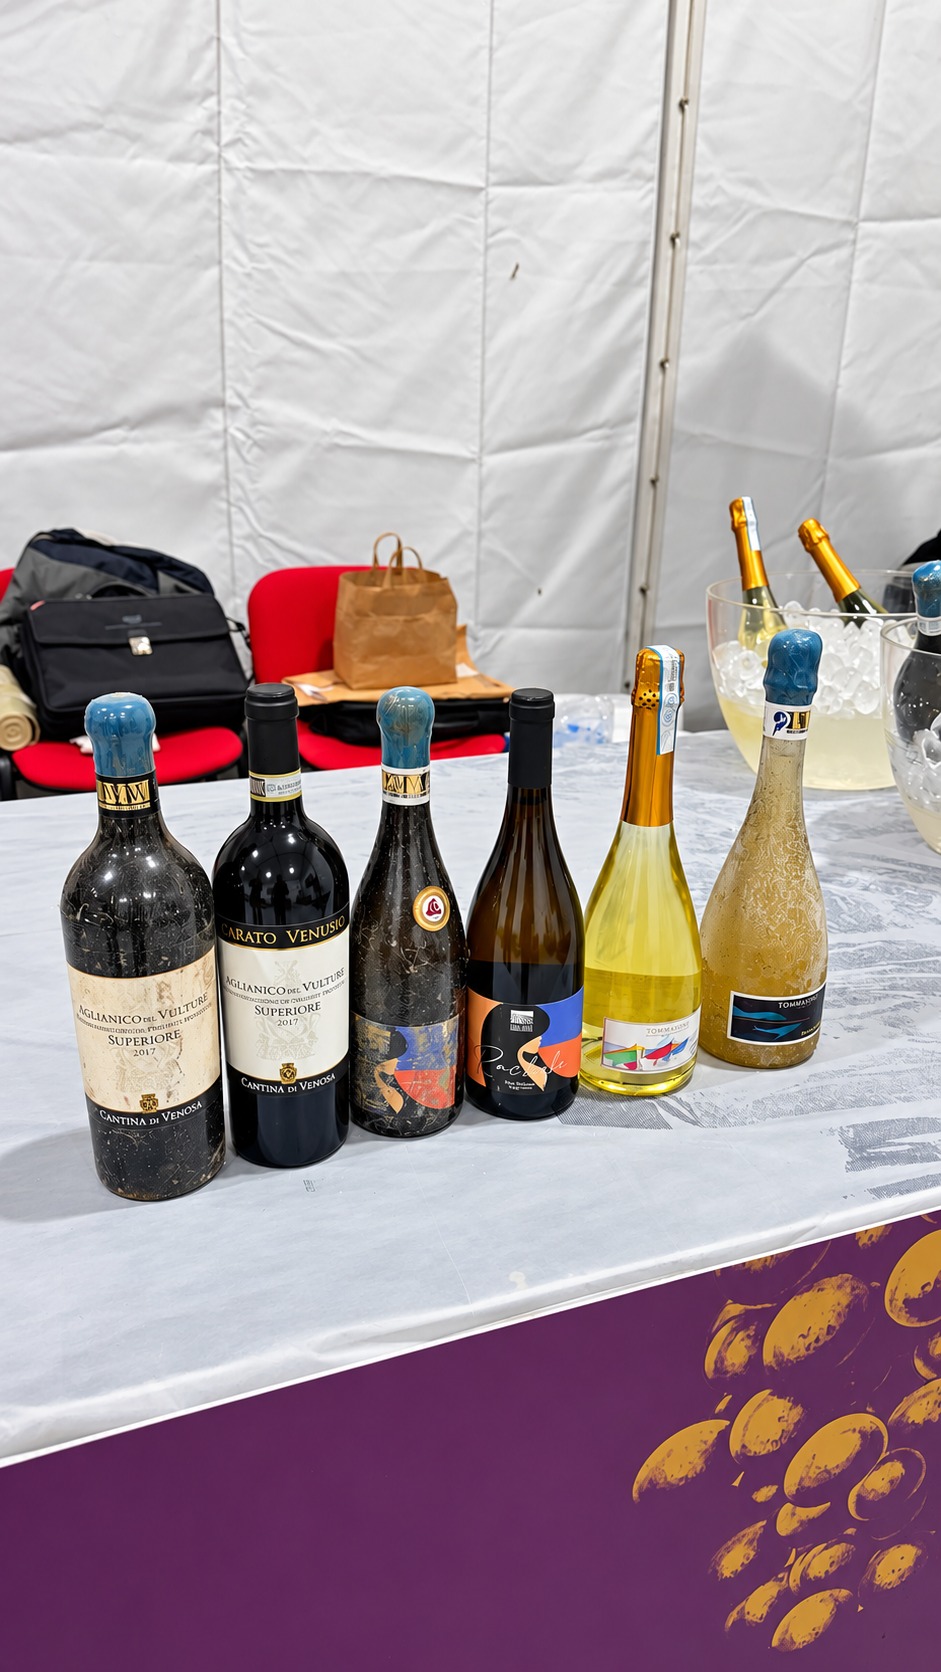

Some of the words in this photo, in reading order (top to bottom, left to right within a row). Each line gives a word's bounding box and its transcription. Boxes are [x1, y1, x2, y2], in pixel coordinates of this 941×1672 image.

[221, 922, 277, 945] CARATO
[286, 915, 345, 944] VENUSIO
[226, 975, 286, 996] AGLIANICO
[302, 967, 345, 993] VULTURE
[78, 1004, 142, 1025] AGLIANICO
[158, 992, 208, 1020] VULTURE
[254, 1001, 321, 1017] SUPERIORE
[778, 993, 819, 1009] TOMMA
[277, 1018, 298, 1027] 2017
[108, 1029, 182, 1047] SUPERIORE
[133, 1047, 156, 1057] 2017
[240, 1076, 285, 1094] CANTINA
[300, 1072, 336, 1090] VENOSA
[100, 1109, 146, 1126] CANTINA
[161, 1100, 203, 1122] VENOSA
